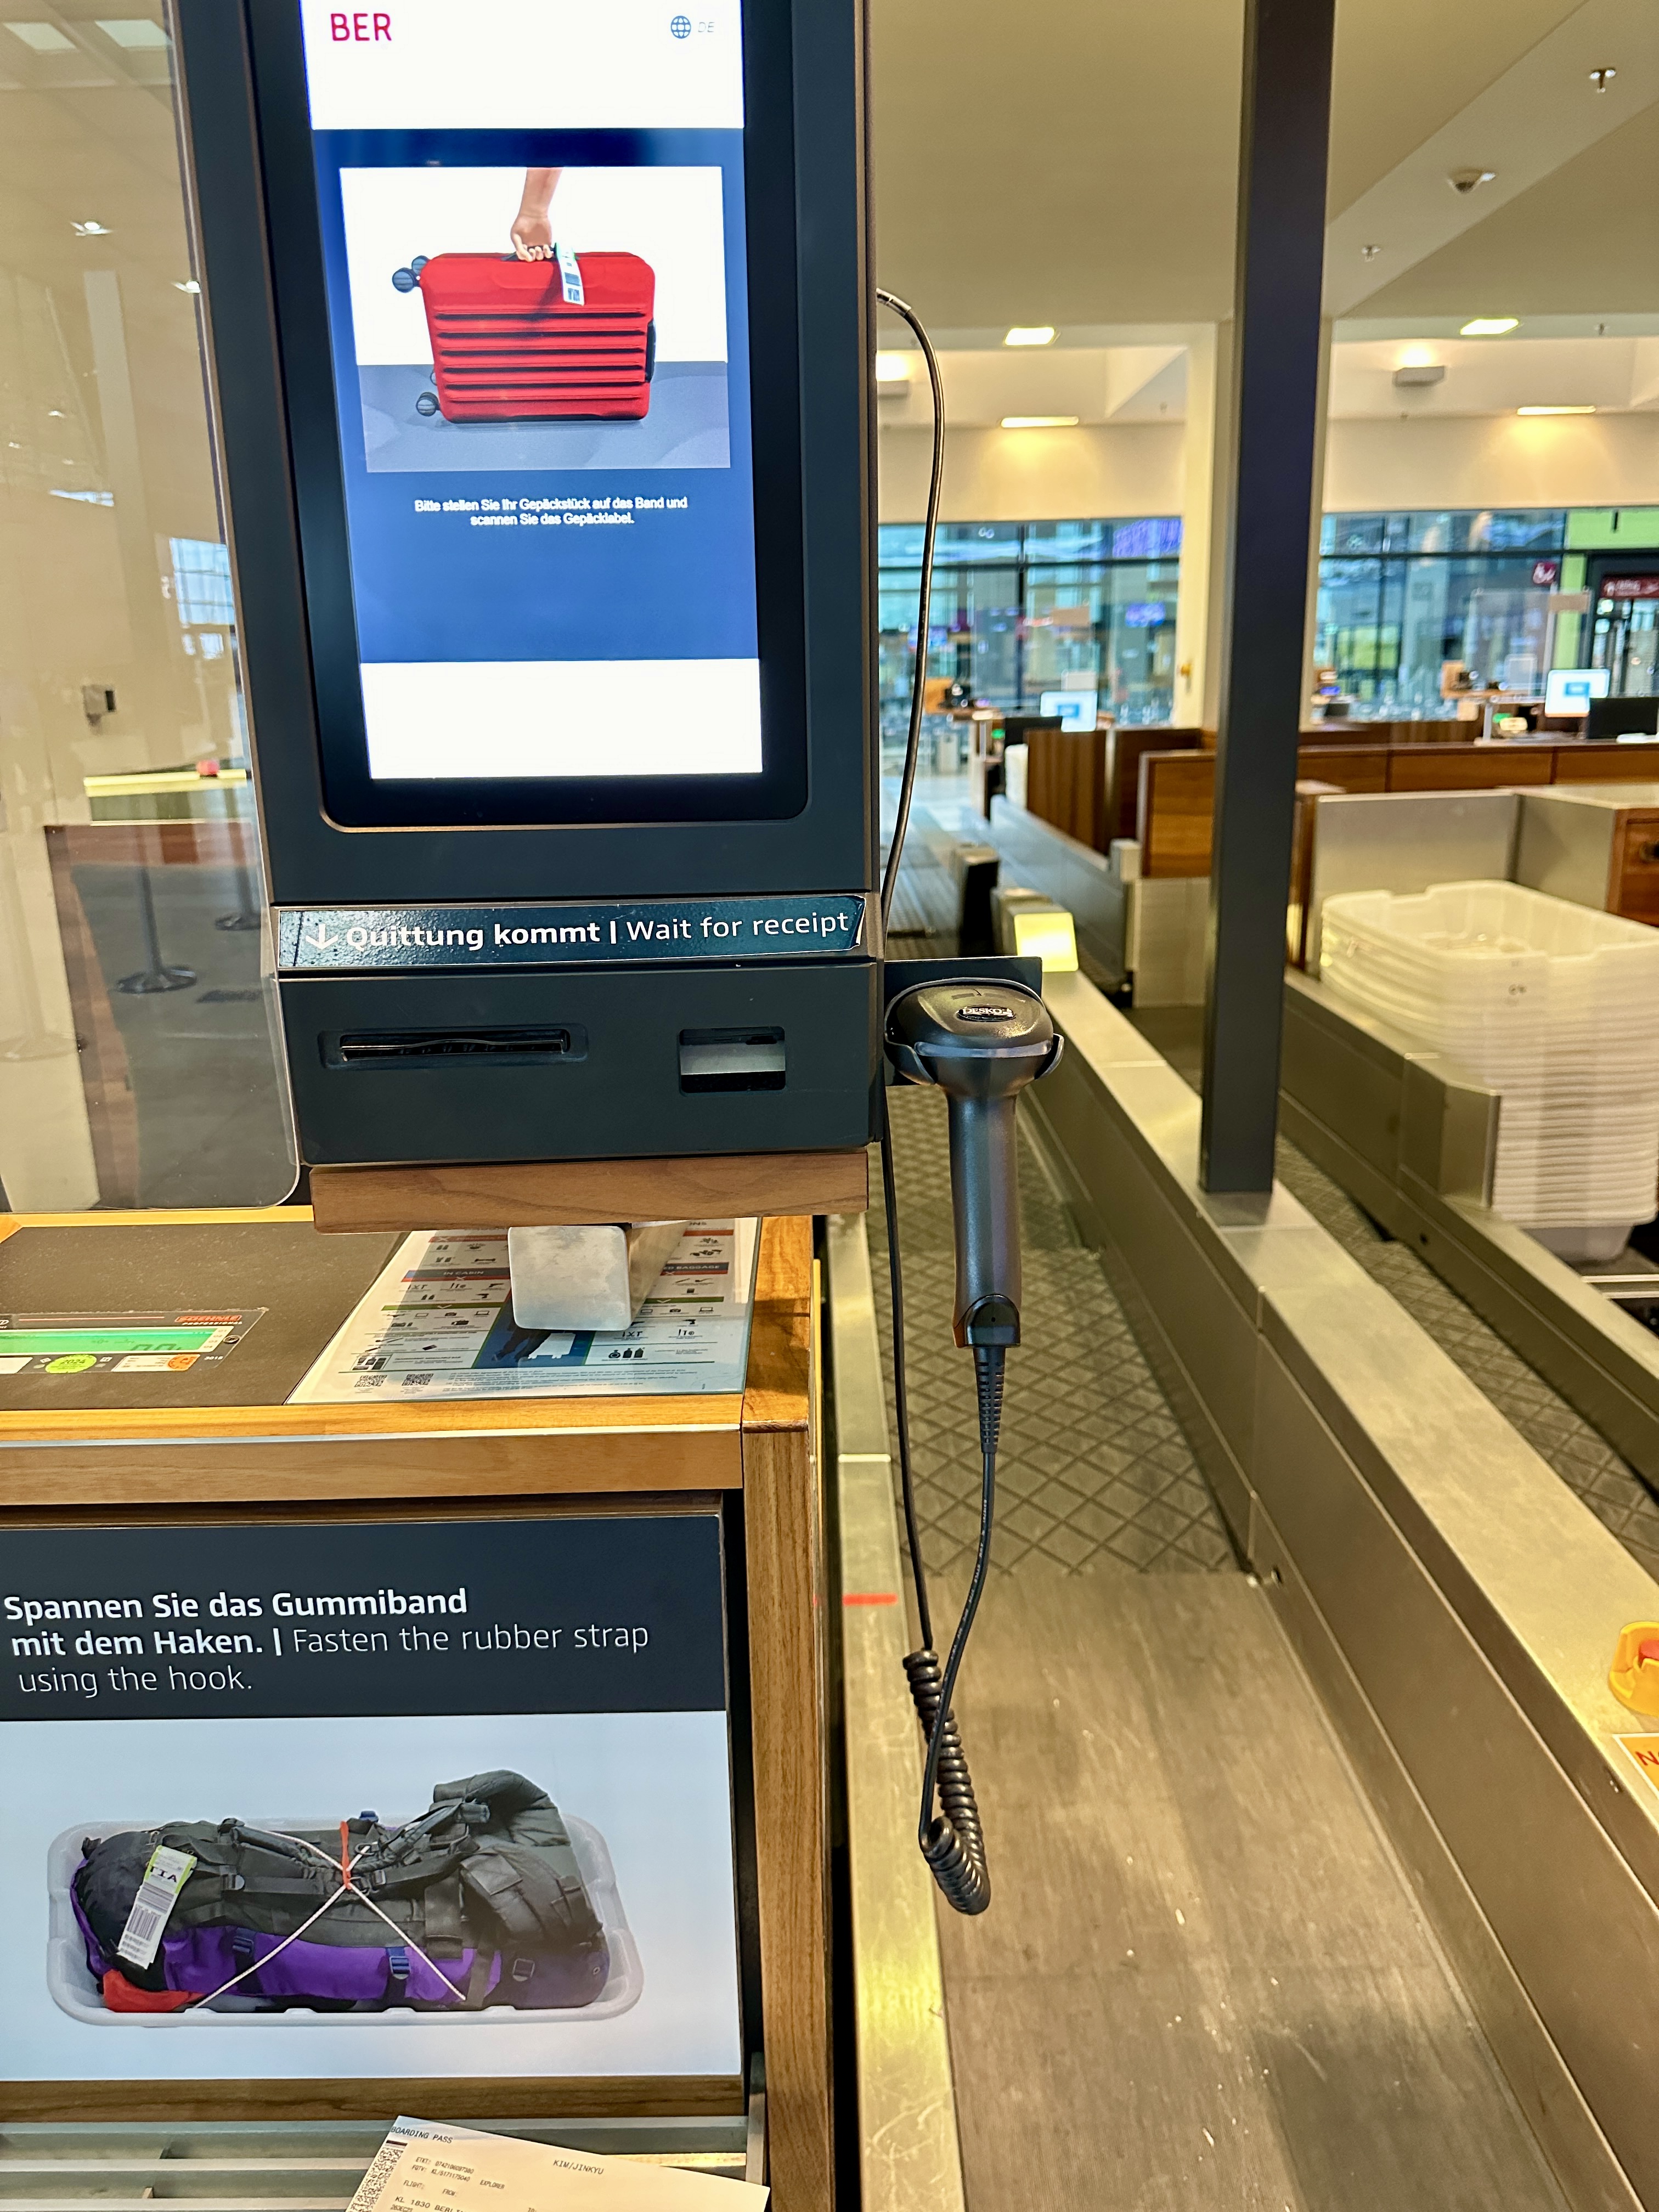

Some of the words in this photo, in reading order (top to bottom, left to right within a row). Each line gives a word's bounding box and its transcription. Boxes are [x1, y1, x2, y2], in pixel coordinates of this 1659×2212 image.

[331, 13, 392, 41] BER
[698, 21, 715, 33] DE
[415, 500, 441, 511] Bitte
[443, 499, 479, 511] stellen
[481, 499, 500, 510] Sie
[502, 498, 517, 510] Ihr
[520, 497, 591, 512] Gepäckstück
[592, 497, 611, 509] auf
[612, 496, 633, 509] das
[635, 496, 664, 509] Band
[667, 496, 687, 508] und
[470, 515, 517, 526] scannen
[520, 513, 538, 524] Sie
[540, 513, 561, 524] das
[563, 512, 635, 526] Gepäcklabel.
[347, 925, 483, 952] Quittung
[494, 922, 600, 945] kommt
[627, 918, 691, 940] Wait
[701, 916, 742, 938] for
[753, 912, 848, 937] receipt
[4, 1596, 144, 1626] Spannen
[152, 1592, 199, 1618] Sie
[209, 1592, 263, 1617] das
[272, 1588, 467, 1616] Gummiband
[11, 1631, 66, 1656] mit
[75, 1630, 144, 1655] dem
[154, 1629, 263, 1654] Haken.
[293, 1628, 388, 1652] Fasten
[399, 1626, 449, 1650] the
[462, 1624, 562, 1650] rubber
[574, 1623, 648, 1654] strap
[19, 1667, 99, 1698] using
[108, 1666, 157, 1690] the
[168, 1665, 252, 1690] hook.
[390, 2126, 430, 2139] BOARDING
[432, 2134, 453, 2144] PASS
[553, 2159, 604, 2175] KIM/JINKYU
[411, 2199, 431, 2209] 1830
